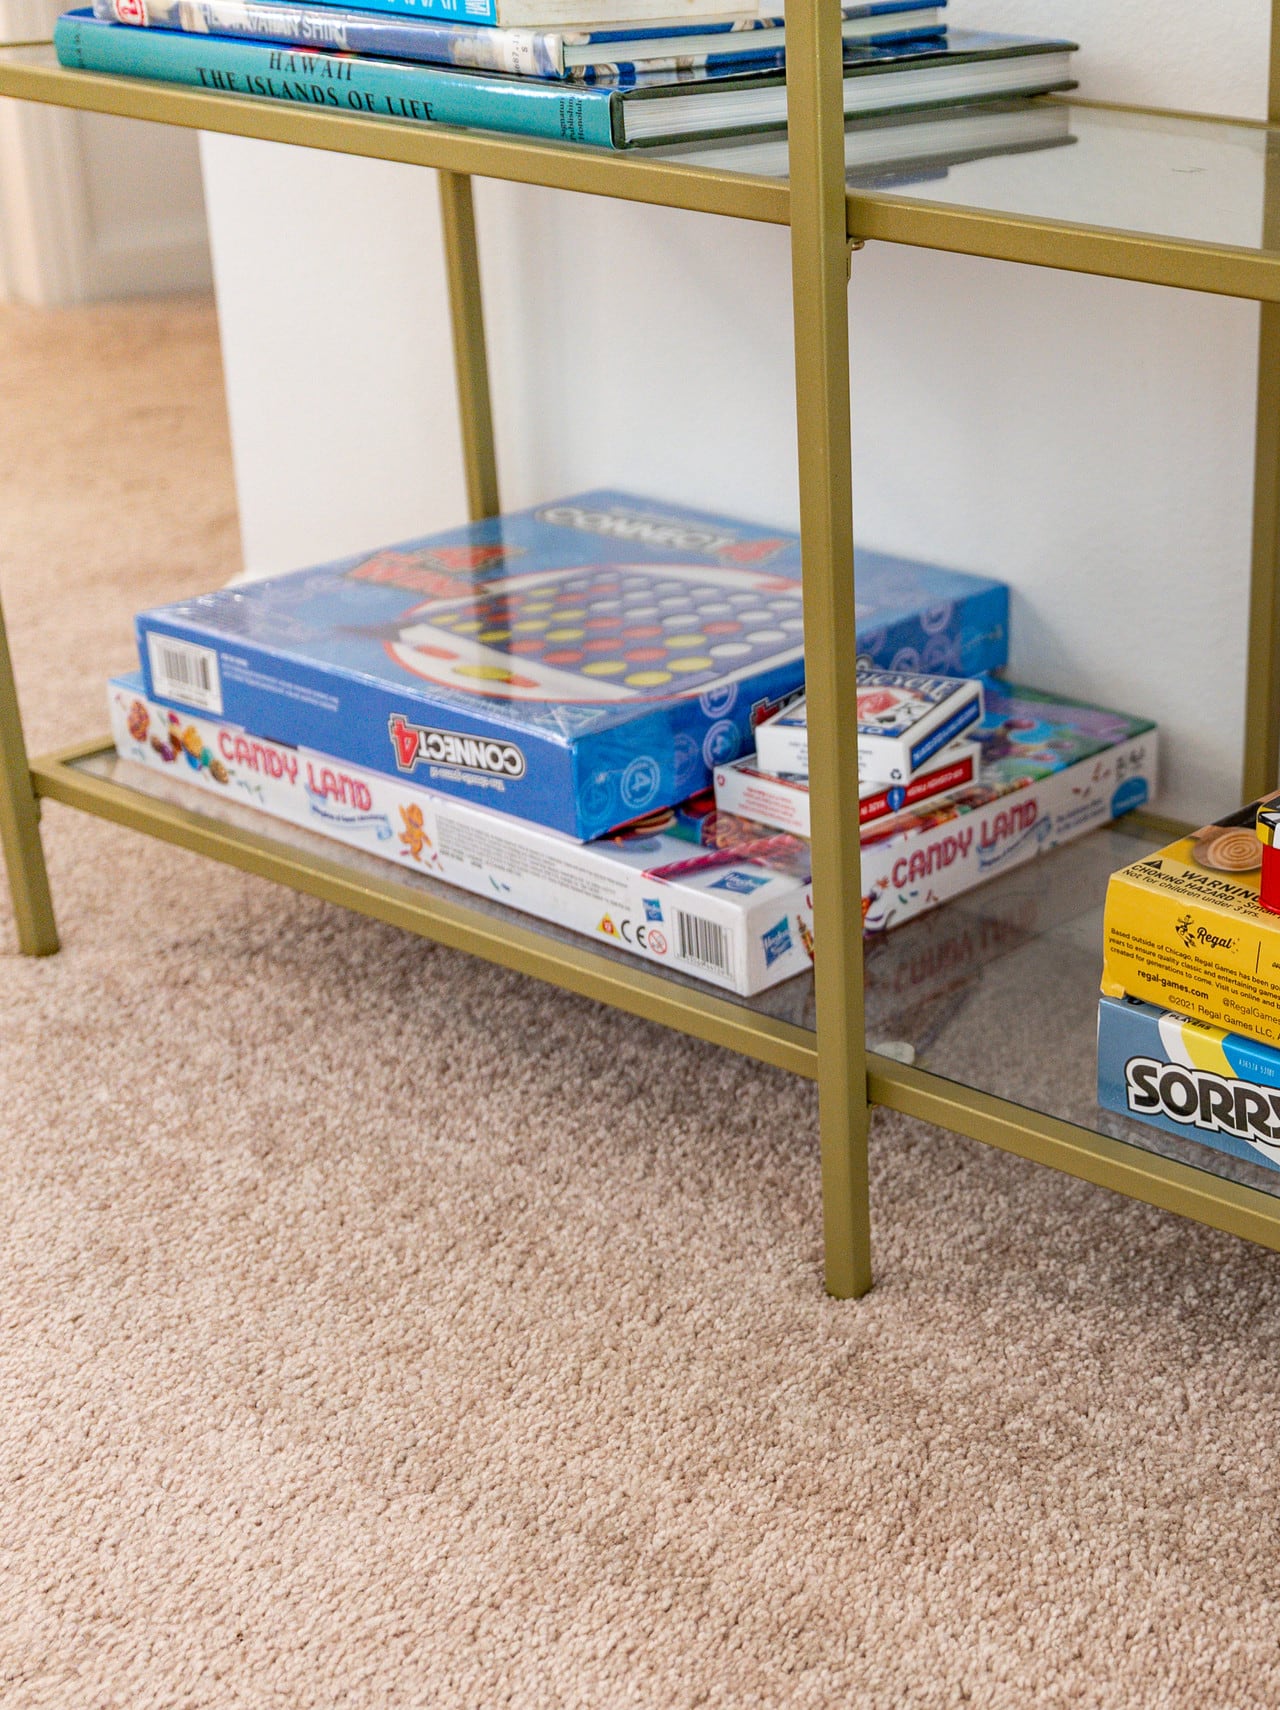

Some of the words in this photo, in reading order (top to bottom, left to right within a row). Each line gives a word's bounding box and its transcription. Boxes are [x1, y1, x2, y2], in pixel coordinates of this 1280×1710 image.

[269, 52, 352, 82] HAWAII
[196, 66, 240, 91] THE
[245, 75, 339, 107] ISLANDS
[348, 90, 376, 112] OF
[385, 95, 438, 122] LIFE
[856, 672, 962, 700] ICYCLE
[393, 718, 419, 769] 4
[417, 730, 523, 776] CONNECT
[216, 727, 299, 786] CANDY
[306, 761, 373, 813] LAND
[890, 826, 973, 890] CANDY
[979, 798, 1039, 849] LAND
[1122, 869, 1141, 881] Not
[1142, 876, 1157, 887] for
[1159, 881, 1201, 898] children
[1201, 893, 1233, 909] under
[1240, 906, 1260, 919] yrs.
[1131, 863, 1184, 885] CHOKING
[1186, 882, 1235, 902] HAZARD
[1110, 928, 1130, 940] Based
[1131, 934, 1155, 948] outside
[1156, 941, 1165, 950] of
[1165, 945, 1193, 962] Chicago,
[1194, 955, 1214, 970] Regal
[1215, 963, 1237, 976] Games
[1238, 969, 1251, 980] has
[1252, 974, 1269, 987] been
[1196, 926, 1234, 949] Regal
[1109, 937, 1126, 950] years
[1134, 945, 1157, 957] ensure
[1157, 951, 1179, 966] quality
[1181, 958, 1202, 973] classic
[1203, 966, 1216, 978] and
[1217, 972, 1257, 993] entertaining
[1258, 988, 1280, 1001] games
[1110, 946, 1135, 959] created
[1135, 953, 1145, 963] for
[1146, 957, 1184, 977] generations
[1193, 974, 1212, 986] come.
[1215, 981, 1229, 992] Visit
[1240, 989, 1260, 1003] online
[1262, 996, 1275, 1008] and
[1137, 969, 1209, 1000] regal-games.com
[1168, 1013, 1213, 1031] PLAYERS
[1197, 1005, 1222, 1020] Regal
[1223, 1014, 1253, 1031] Games
[1255, 1025, 1275, 1040] LLC,
